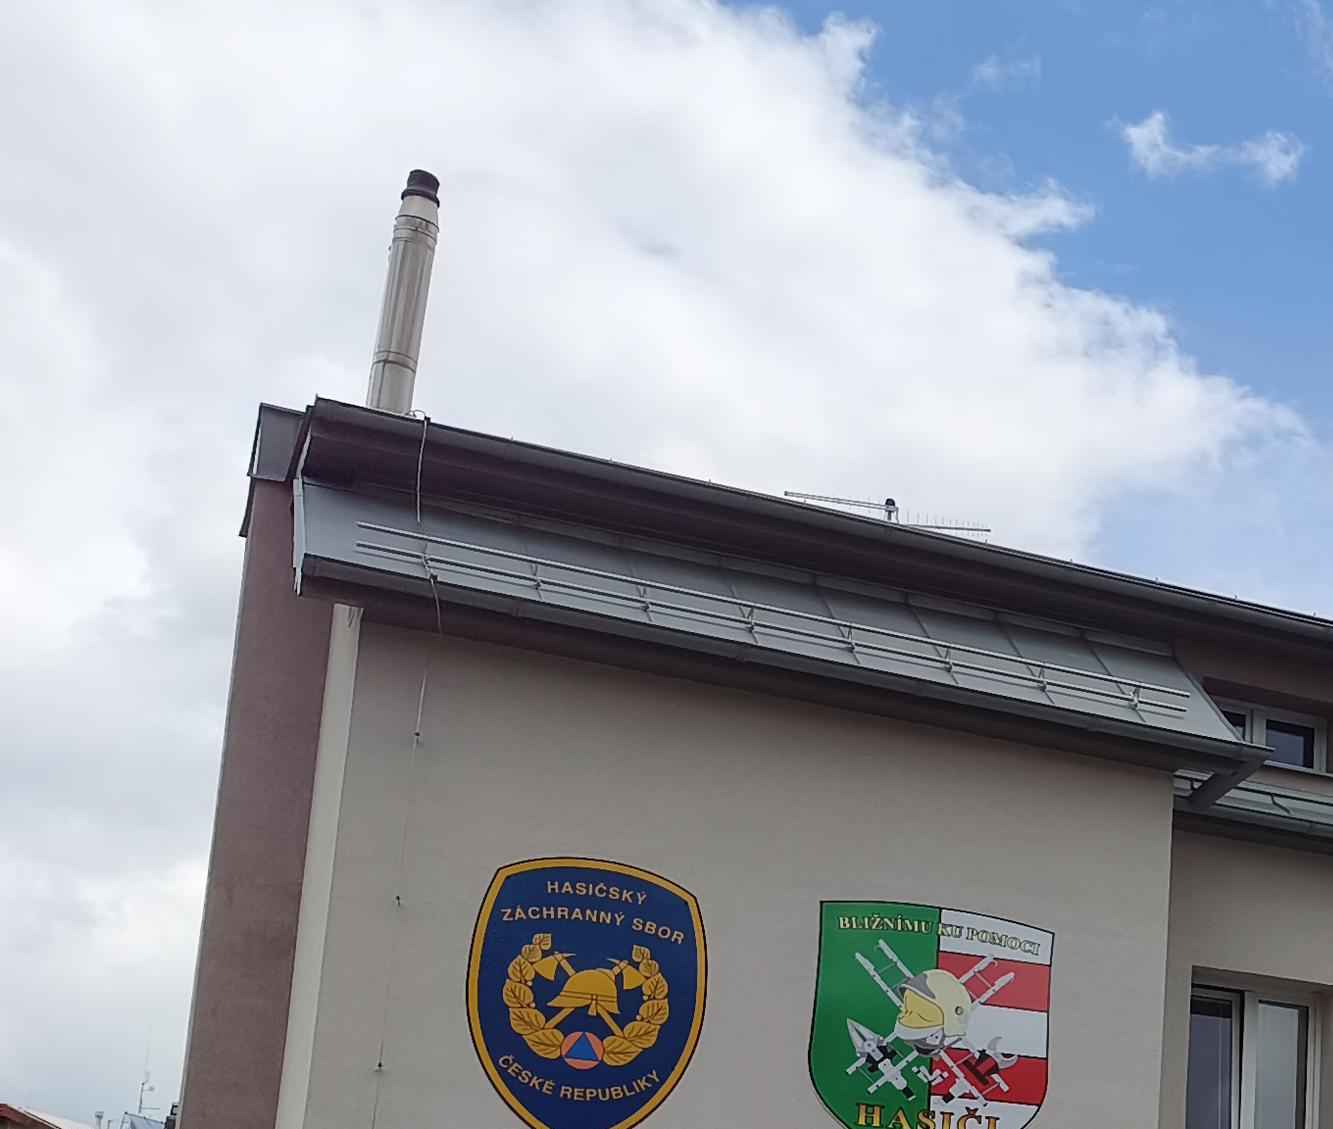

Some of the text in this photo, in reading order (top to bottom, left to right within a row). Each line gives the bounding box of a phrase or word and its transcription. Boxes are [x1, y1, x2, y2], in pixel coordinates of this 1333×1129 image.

[547, 881, 647, 905] HASIČSKÝ
[501, 906, 685, 944] ZÁCHRANNÝ SBOR
[839, 913, 1040, 955] BLIŽNÍMU KU POMOCI
[499, 1055, 661, 1102] ČESKÉ REPUBLIKY
